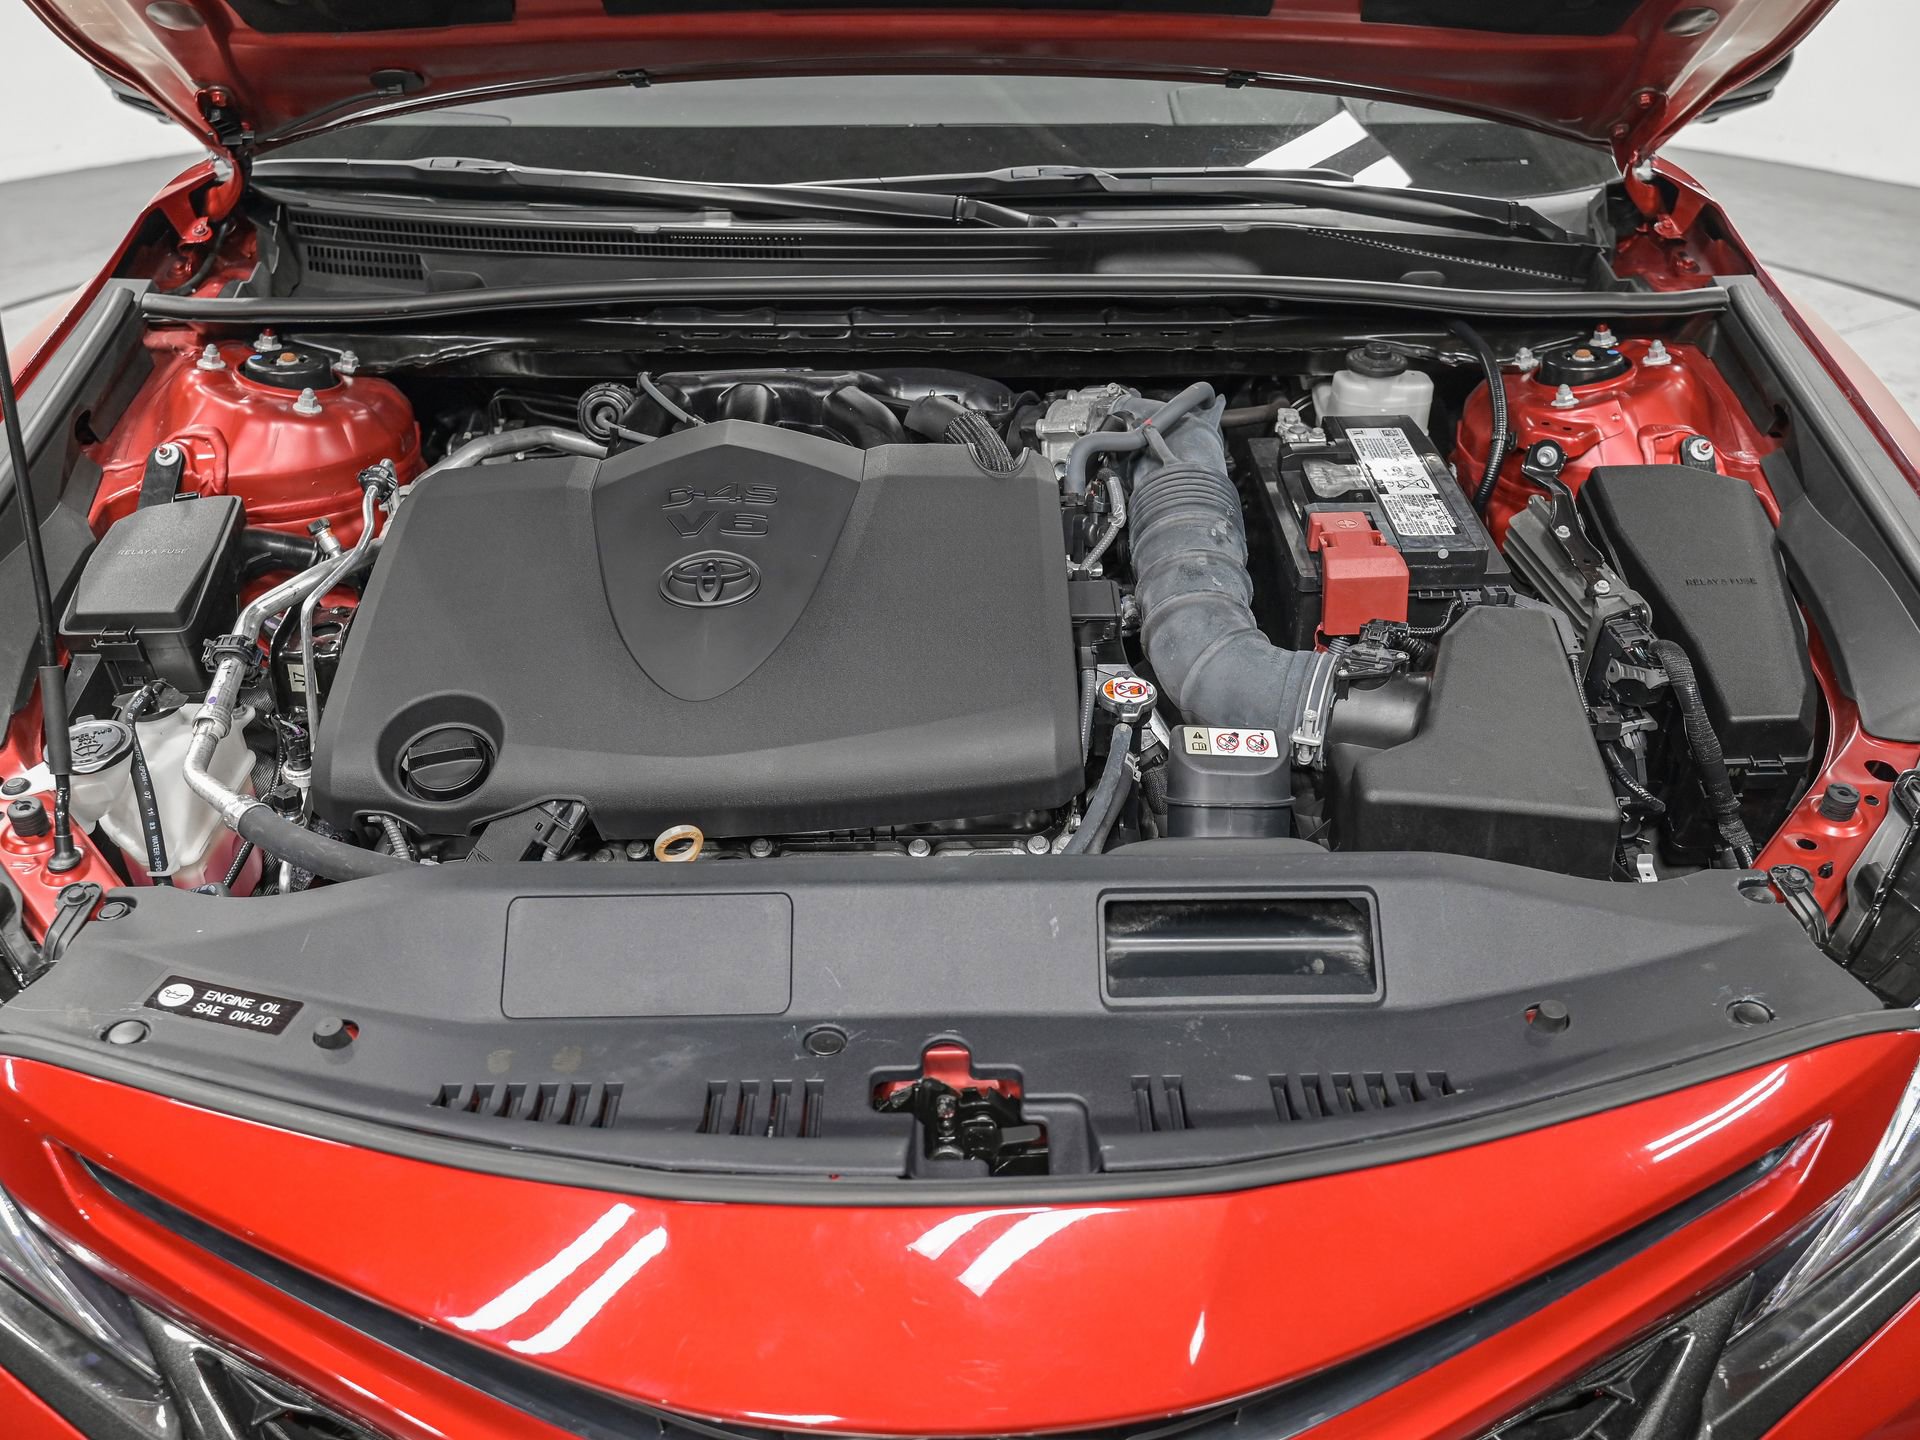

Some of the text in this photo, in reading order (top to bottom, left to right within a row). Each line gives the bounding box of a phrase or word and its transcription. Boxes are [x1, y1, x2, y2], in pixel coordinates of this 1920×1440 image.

[662, 482, 778, 509] D-4S
[666, 511, 768, 538] V6
[117, 548, 151, 556] RELAY
[1685, 578, 1718, 586] RELAY
[152, 835, 160, 856] WATER
[202, 990, 281, 1015] ENGINE OIL
[192, 1003, 274, 1027] SAE 0W-20
